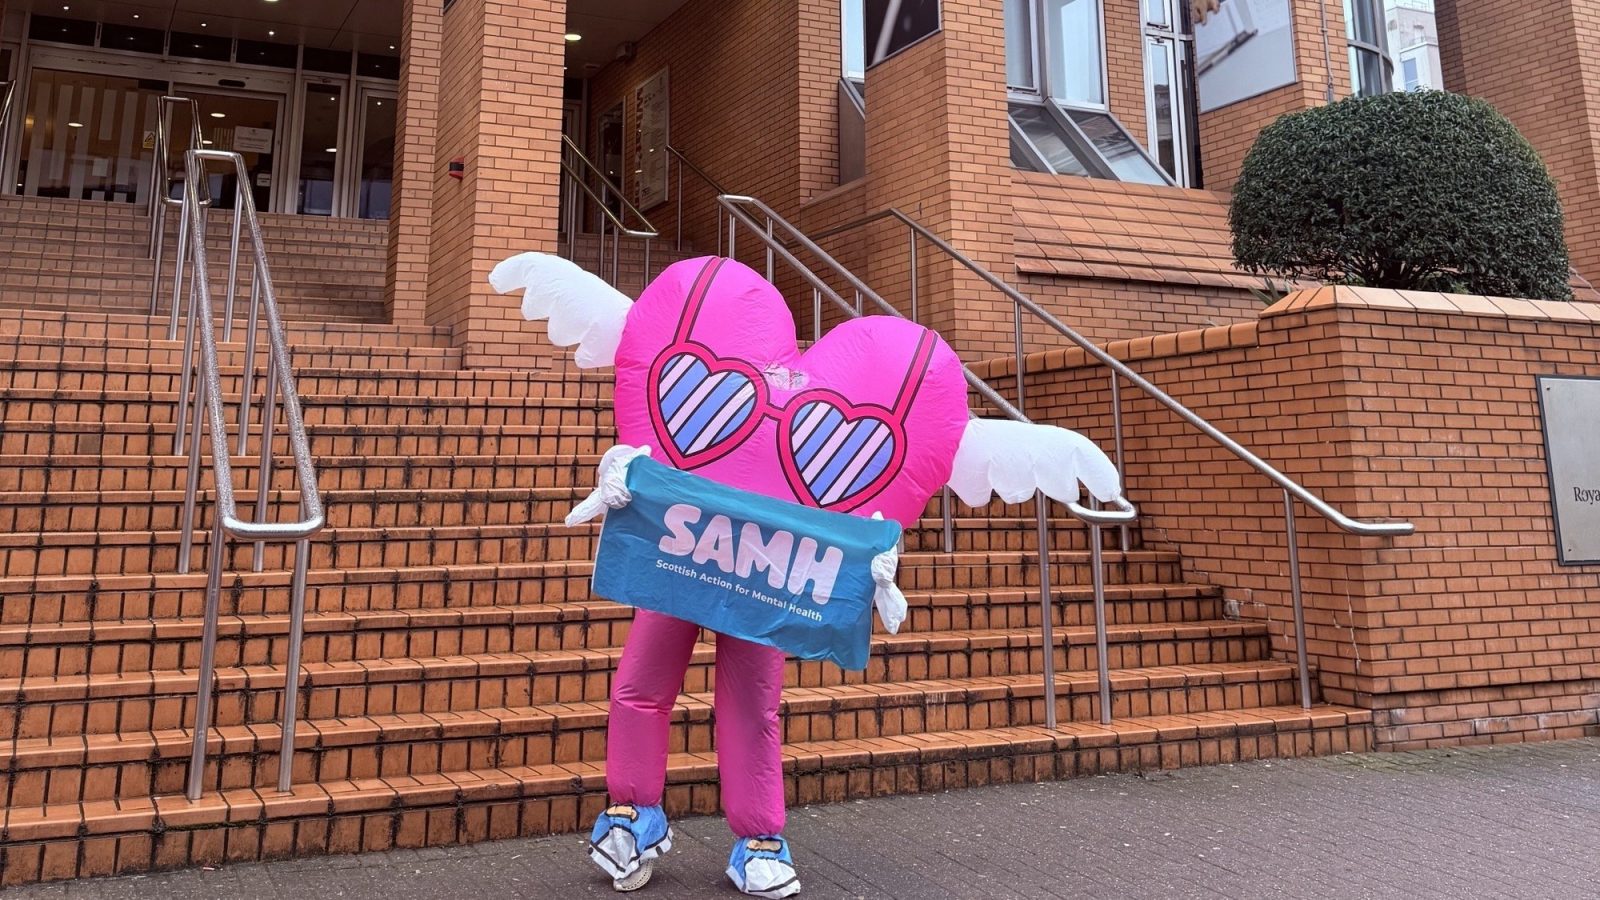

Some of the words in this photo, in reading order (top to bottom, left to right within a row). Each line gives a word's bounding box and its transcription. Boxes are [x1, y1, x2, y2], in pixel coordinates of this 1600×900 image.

[656, 559, 697, 578] Scottish
[699, 573, 733, 590] Action
[735, 583, 750, 595] for
[751, 590, 787, 609] Mental
[788, 603, 823, 622] Health
[658, 503, 843, 605] SAMH
